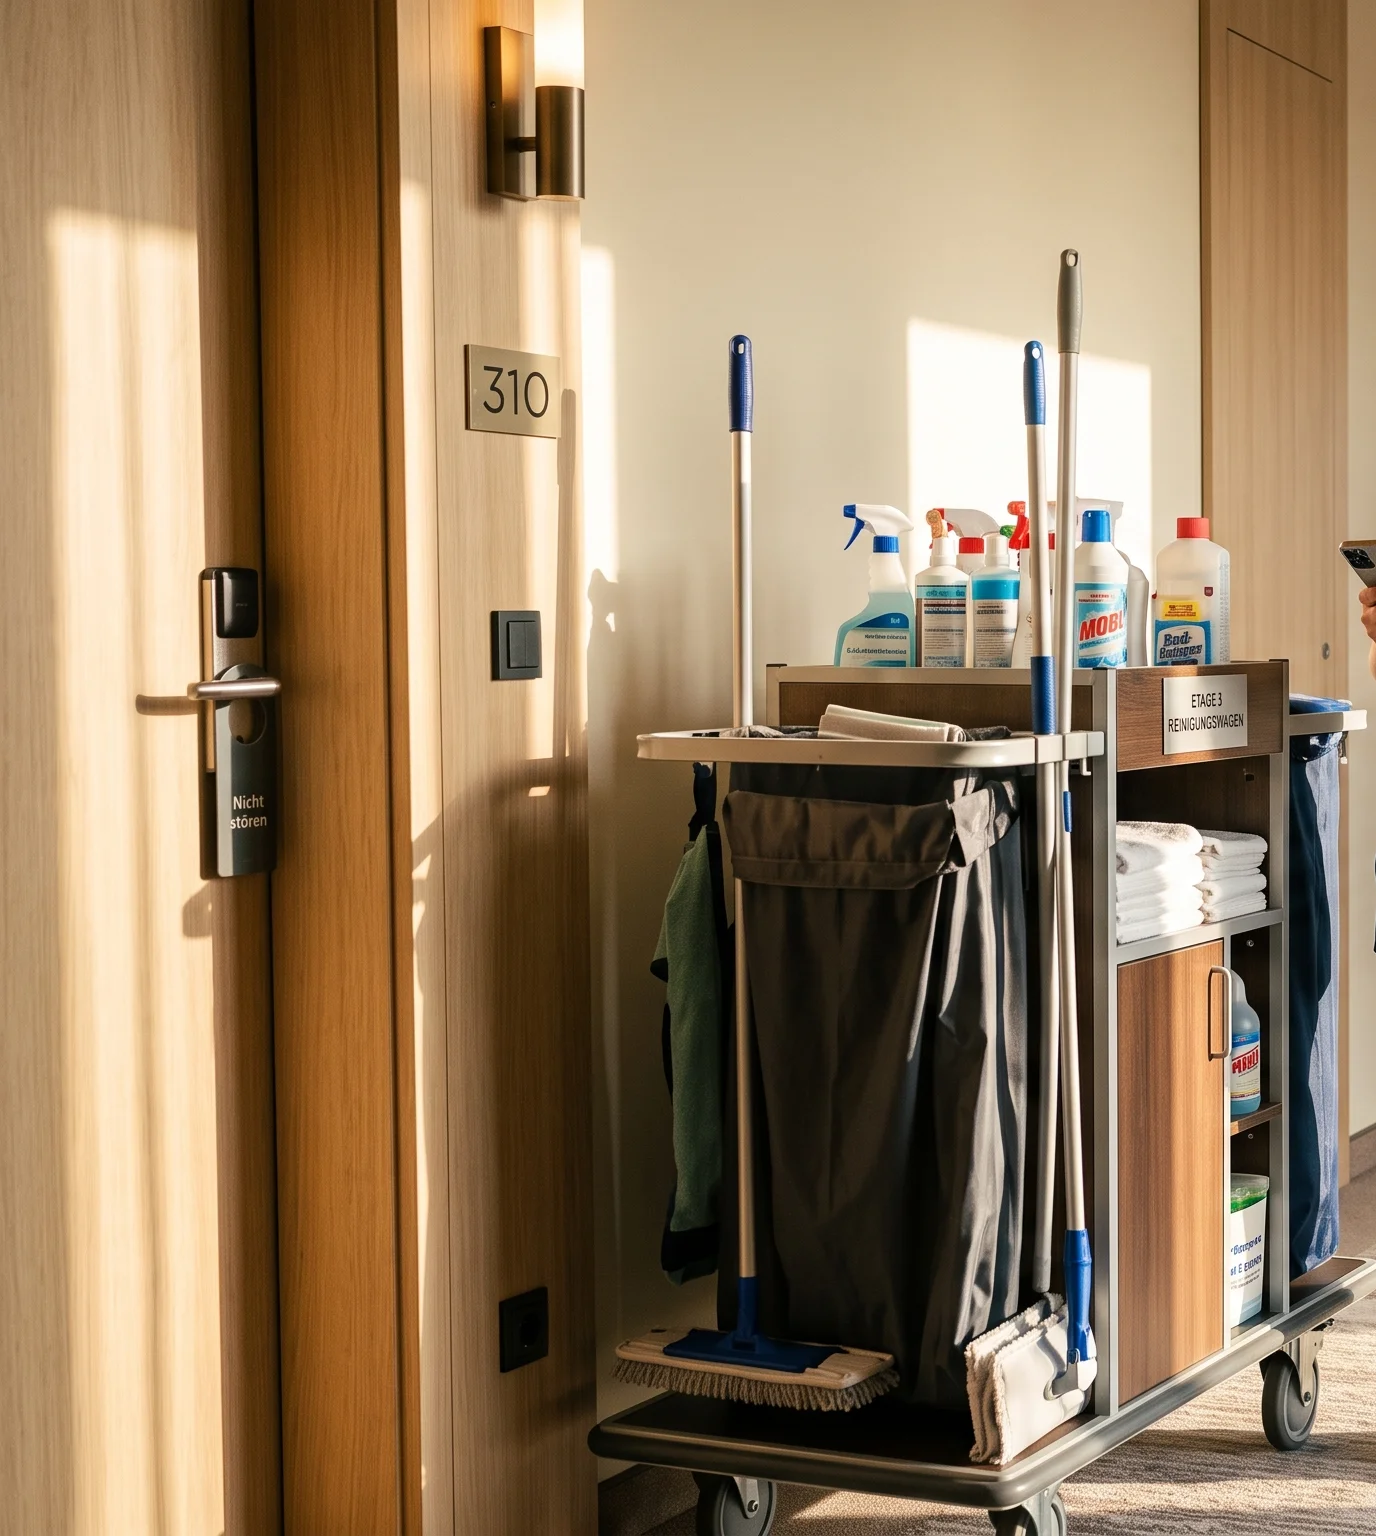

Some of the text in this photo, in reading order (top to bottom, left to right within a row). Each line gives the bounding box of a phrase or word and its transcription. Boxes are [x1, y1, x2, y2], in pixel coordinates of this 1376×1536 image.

[482, 365, 549, 418] 310
[1191, 692, 1223, 708] ETAGE 3
[1168, 713, 1244, 732] REINIGUNGSWAGEN
[233, 794, 265, 810] Nicht
